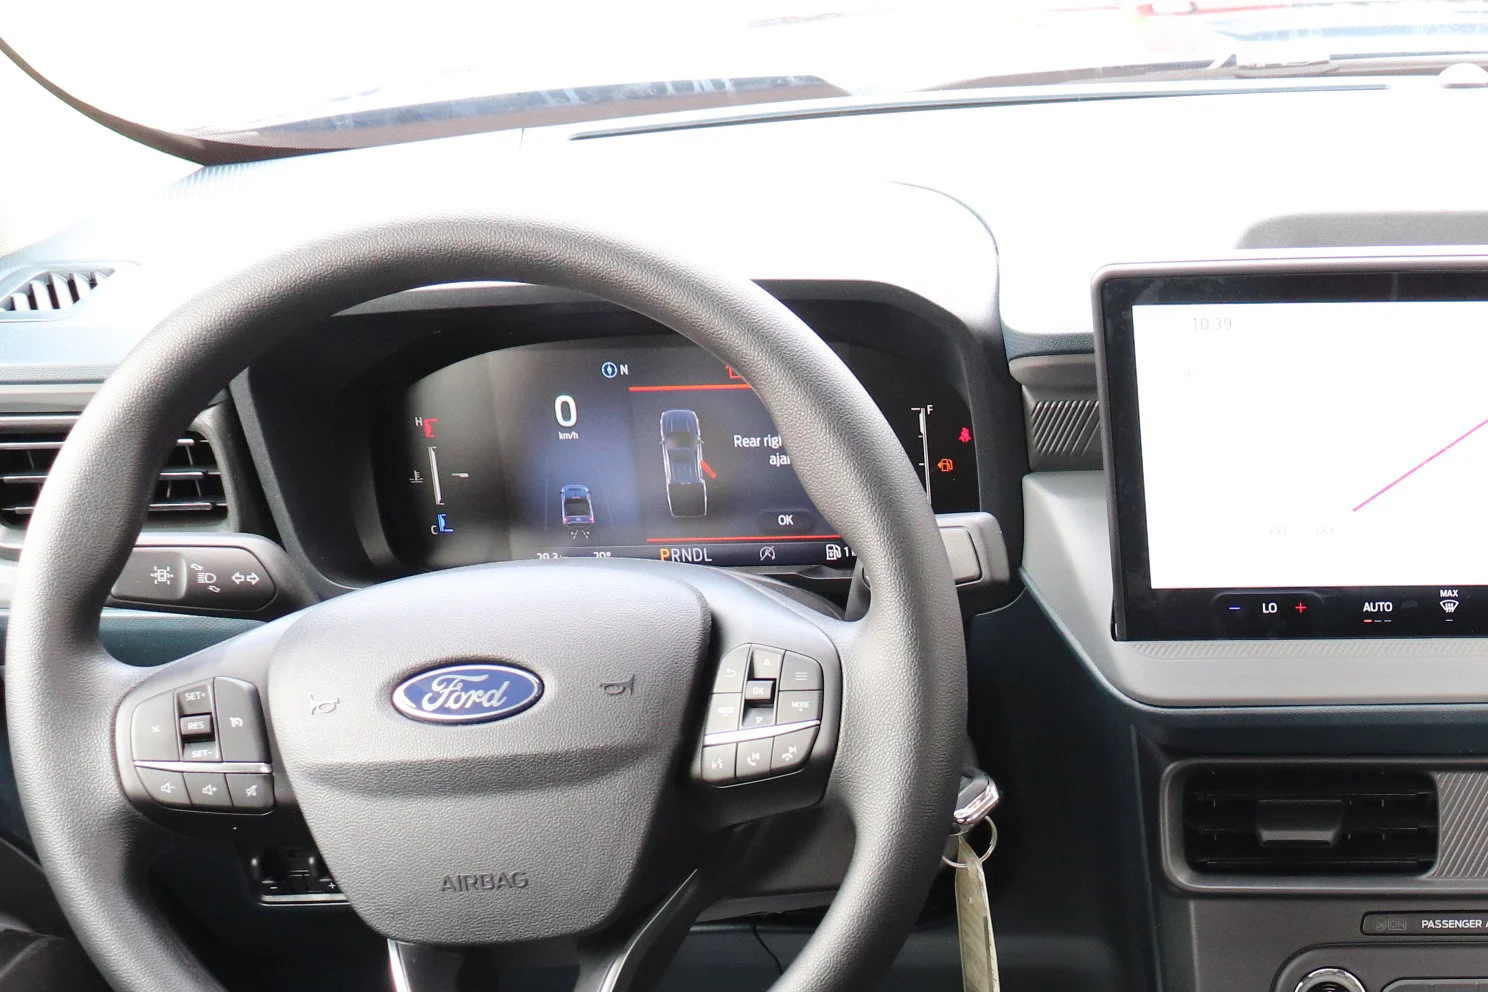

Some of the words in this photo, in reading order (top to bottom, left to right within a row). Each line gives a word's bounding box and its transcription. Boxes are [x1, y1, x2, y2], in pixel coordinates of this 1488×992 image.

[619, 364, 629, 376] N
[554, 394, 578, 427] 0
[926, 404, 934, 415] F
[414, 416, 423, 427] H
[558, 431, 579, 440] km/h
[733, 434, 761, 448] Rear
[778, 514, 794, 526] OK
[430, 524, 438, 535] C
[1440, 589, 1459, 598] MAX
[1262, 602, 1278, 615] LO
[1363, 602, 1393, 614] AUTO
[421, 674, 511, 713] Ford
[752, 686, 765, 695] OK
[187, 721, 204, 730] RES
[440, 871, 530, 893] AIRBAG
[1421, 919, 1483, 930] PASSENGER
